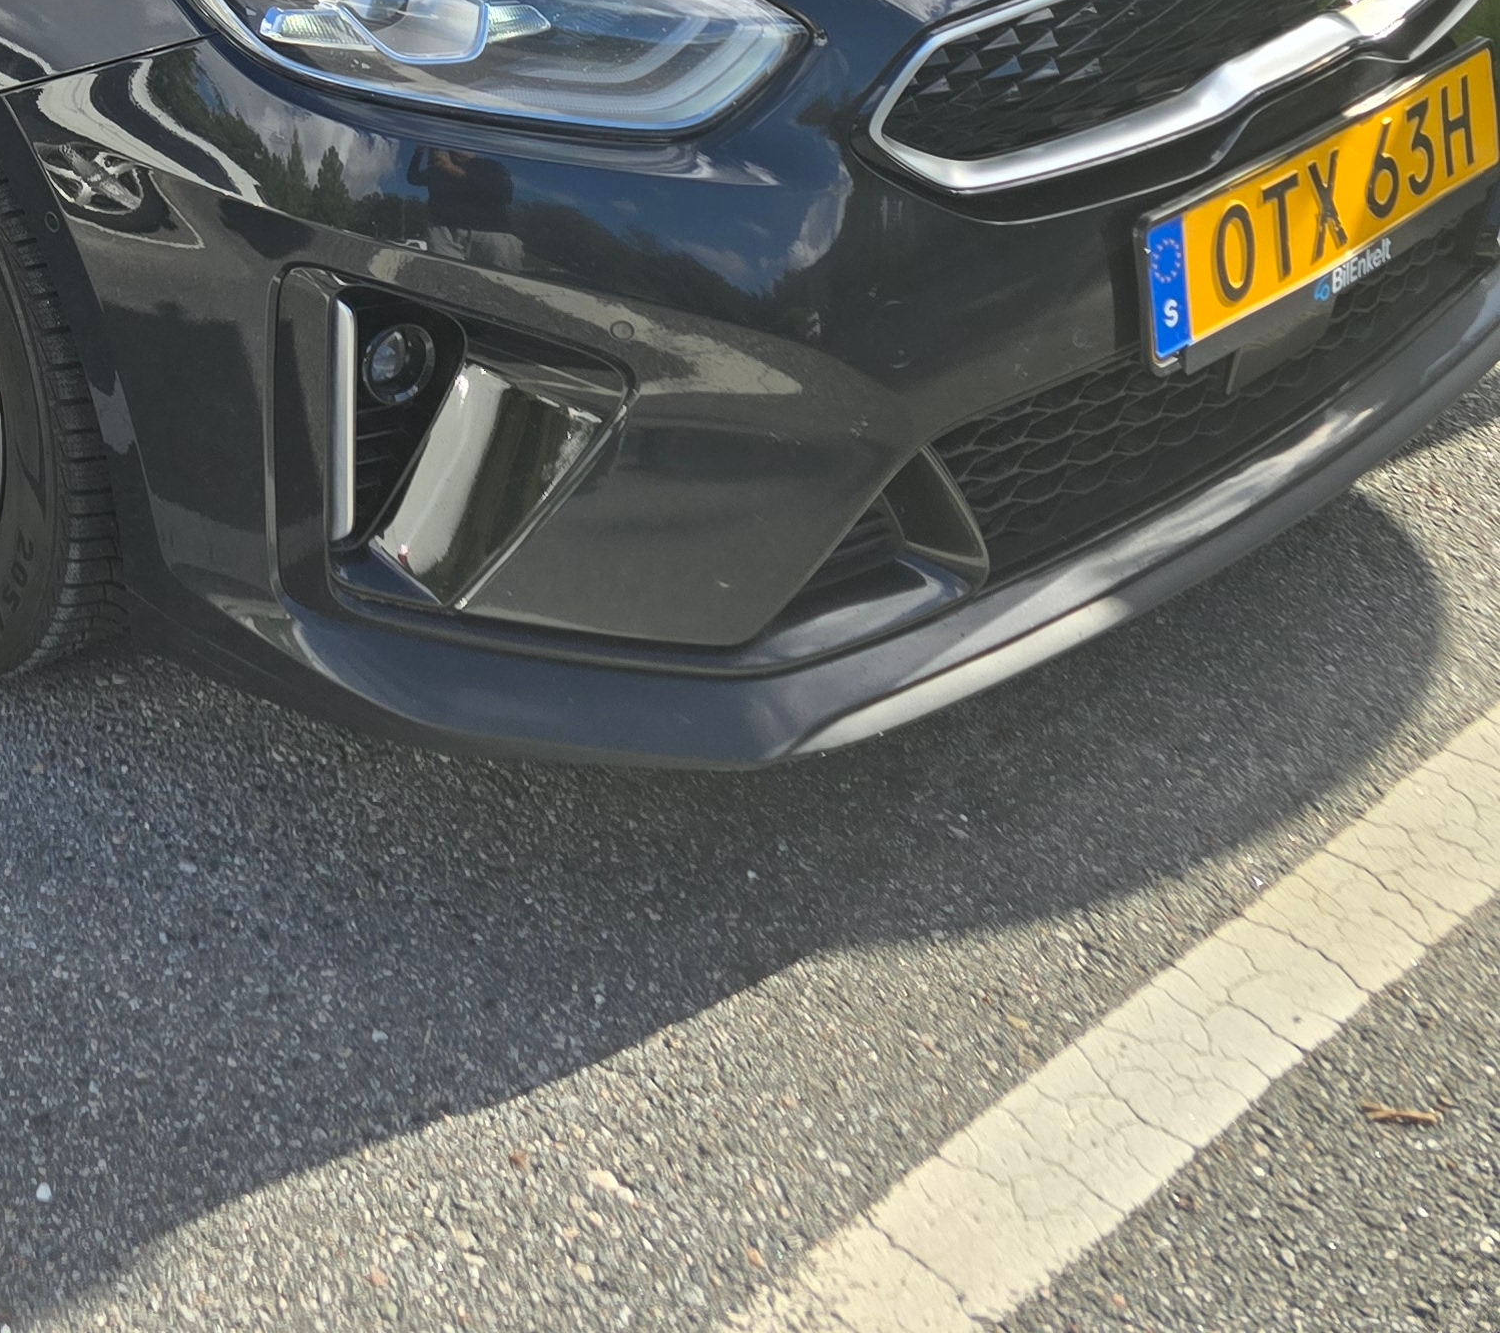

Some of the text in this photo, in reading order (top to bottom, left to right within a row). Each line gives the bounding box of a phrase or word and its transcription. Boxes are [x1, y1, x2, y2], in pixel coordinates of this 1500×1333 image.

[1212, 74, 1476, 305] OTX 63H
[1331, 237, 1392, 295] BilEnkelt
[1162, 299, 1179, 328] S
